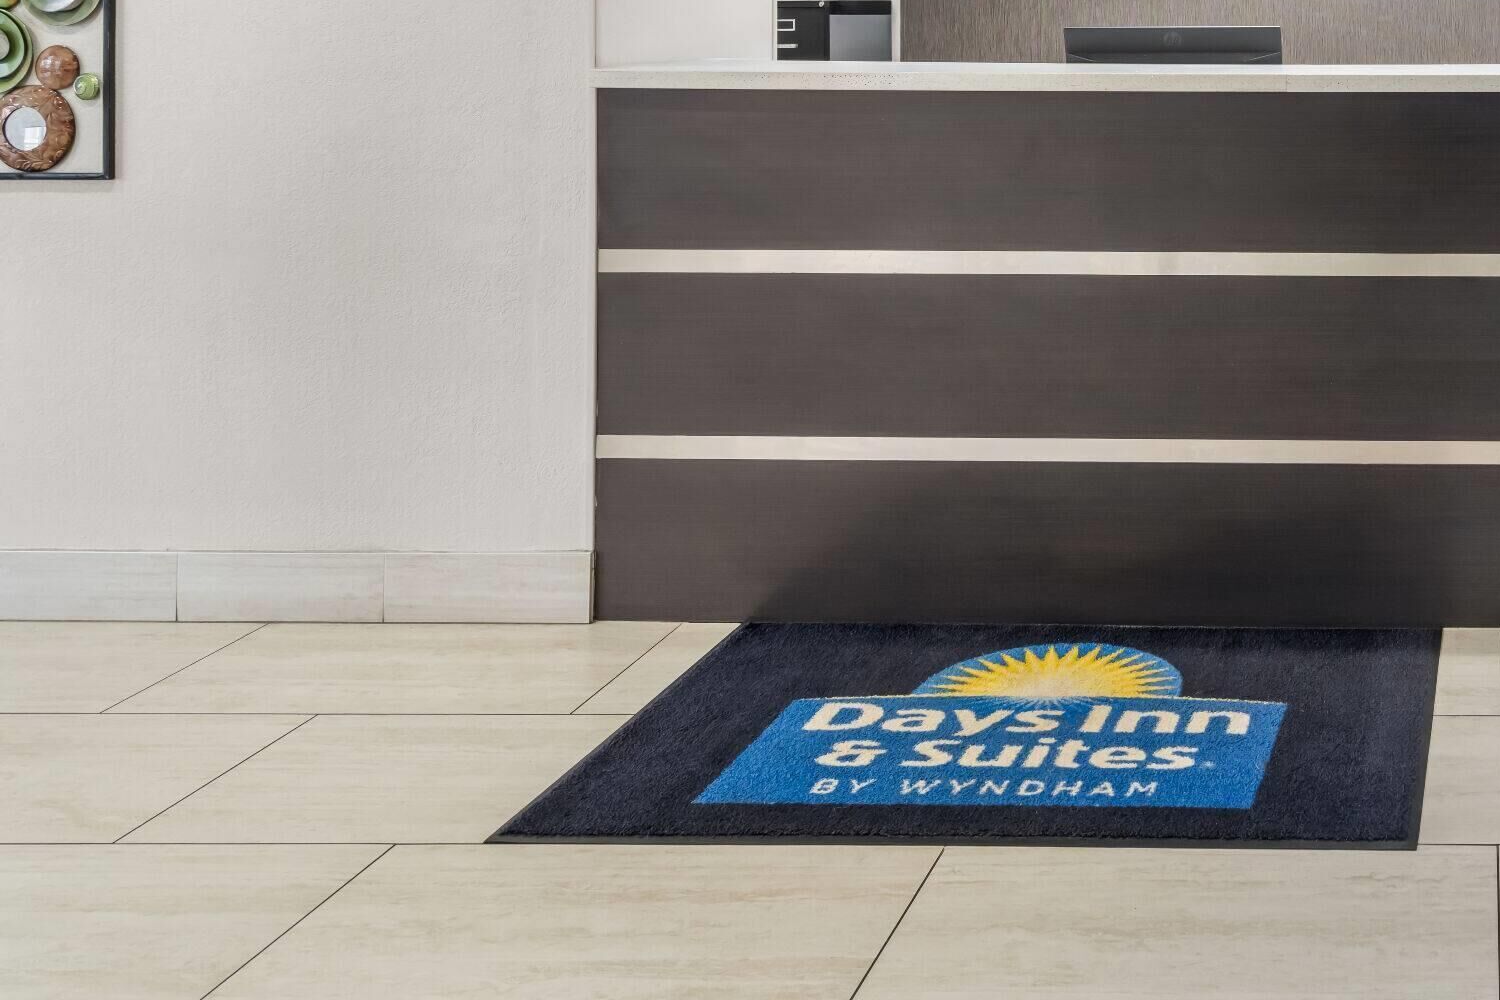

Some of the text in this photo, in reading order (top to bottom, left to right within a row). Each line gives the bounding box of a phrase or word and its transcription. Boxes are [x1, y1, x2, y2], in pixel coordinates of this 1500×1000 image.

[801, 702, 1251, 737] Days Inn
[814, 739, 888, 767] &
[809, 777, 1158, 797] BY WYNDHAM
